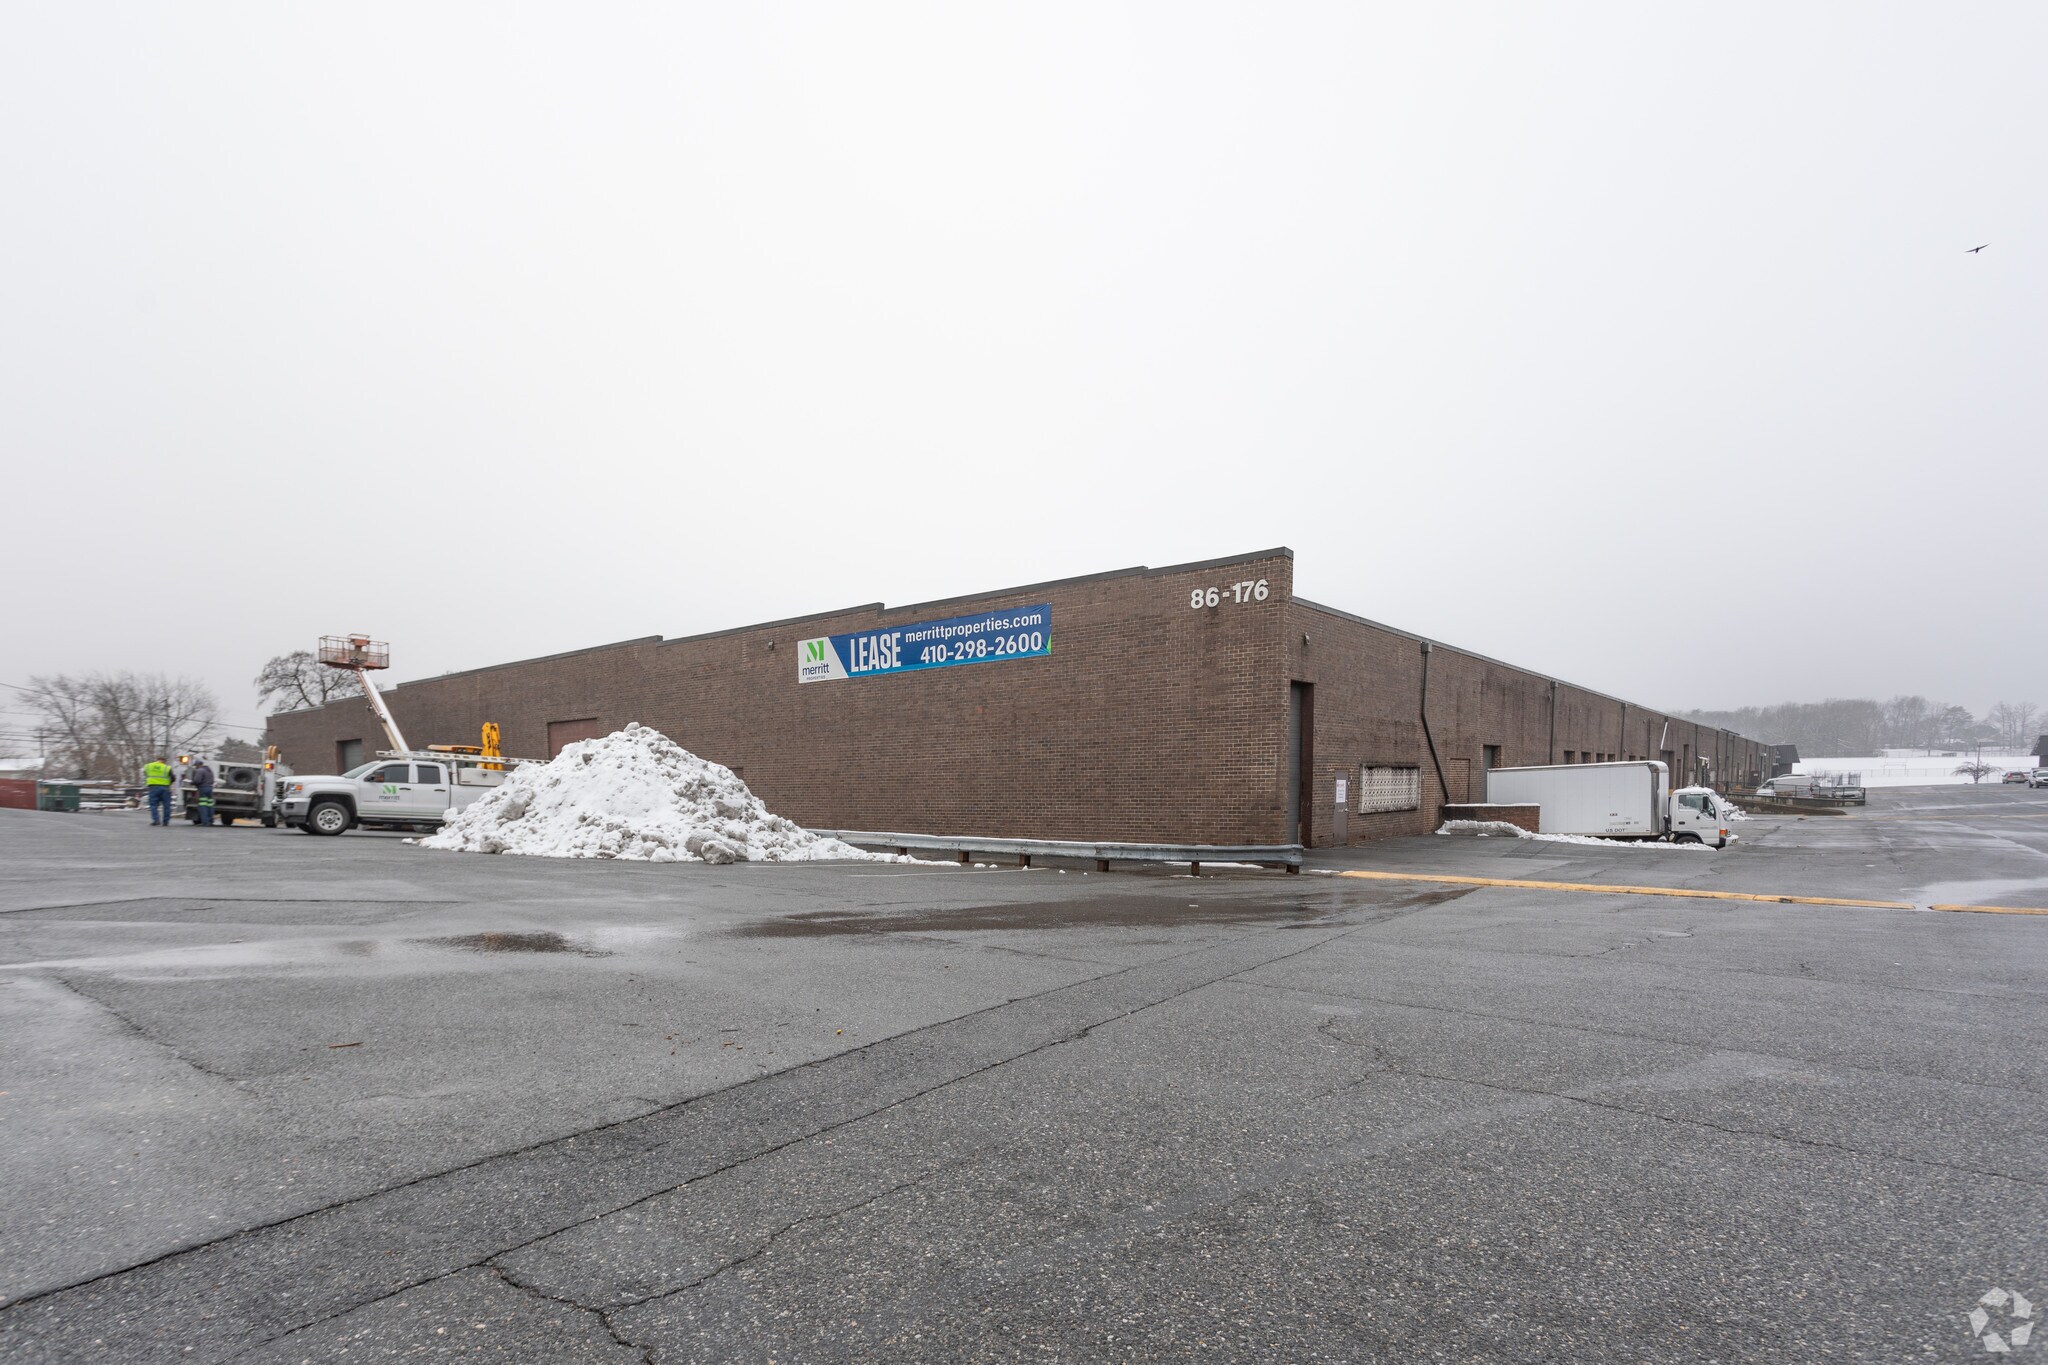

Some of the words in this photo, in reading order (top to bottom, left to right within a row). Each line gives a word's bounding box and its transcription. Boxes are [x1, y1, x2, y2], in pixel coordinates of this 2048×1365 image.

[1190, 579, 1269, 609] 86-176
[905, 613, 1042, 643] merrittproperties.com
[850, 632, 902, 672] LEASE
[920, 631, 1042, 664] 410-298-2600
[802, 662, 830, 676] merritt
